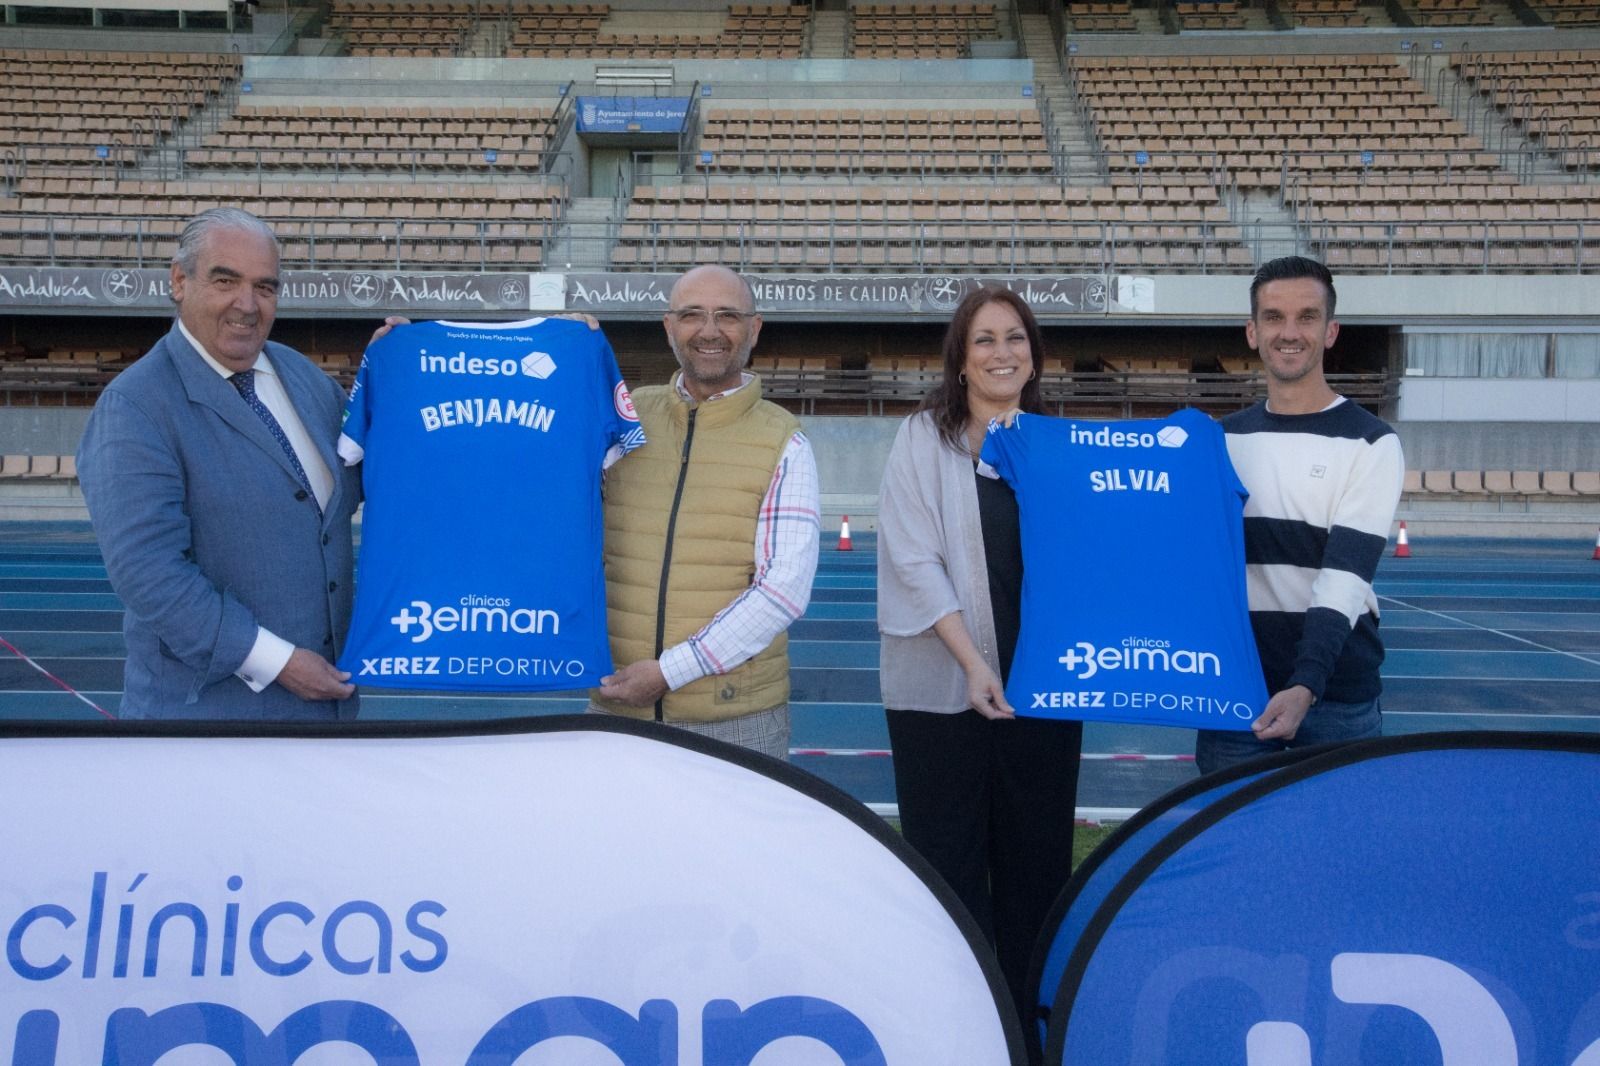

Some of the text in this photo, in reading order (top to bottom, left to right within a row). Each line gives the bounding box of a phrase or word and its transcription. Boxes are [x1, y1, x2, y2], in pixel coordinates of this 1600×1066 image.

[0, 275, 96, 300] Andalucía
[281, 282, 339, 298] ALIDAD
[390, 274, 484, 302] Andalucía
[571, 280, 669, 303] Andalucía
[823, 285, 843, 301] DE
[850, 286, 910, 302] CALIDA
[420, 349, 518, 376] indeso
[420, 398, 556, 432] BENJAMÍN
[1071, 424, 1155, 448] indeso
[1090, 469, 1171, 493] SILVIA
[460, 594, 511, 607] clínicas
[1122, 636, 1171, 648] clínicas
[358, 657, 585, 677] XEREZ DEPORTIVO
[1030, 691, 1253, 720] XEREZ DEPORTIVO
[6, 871, 449, 981] clínicas
